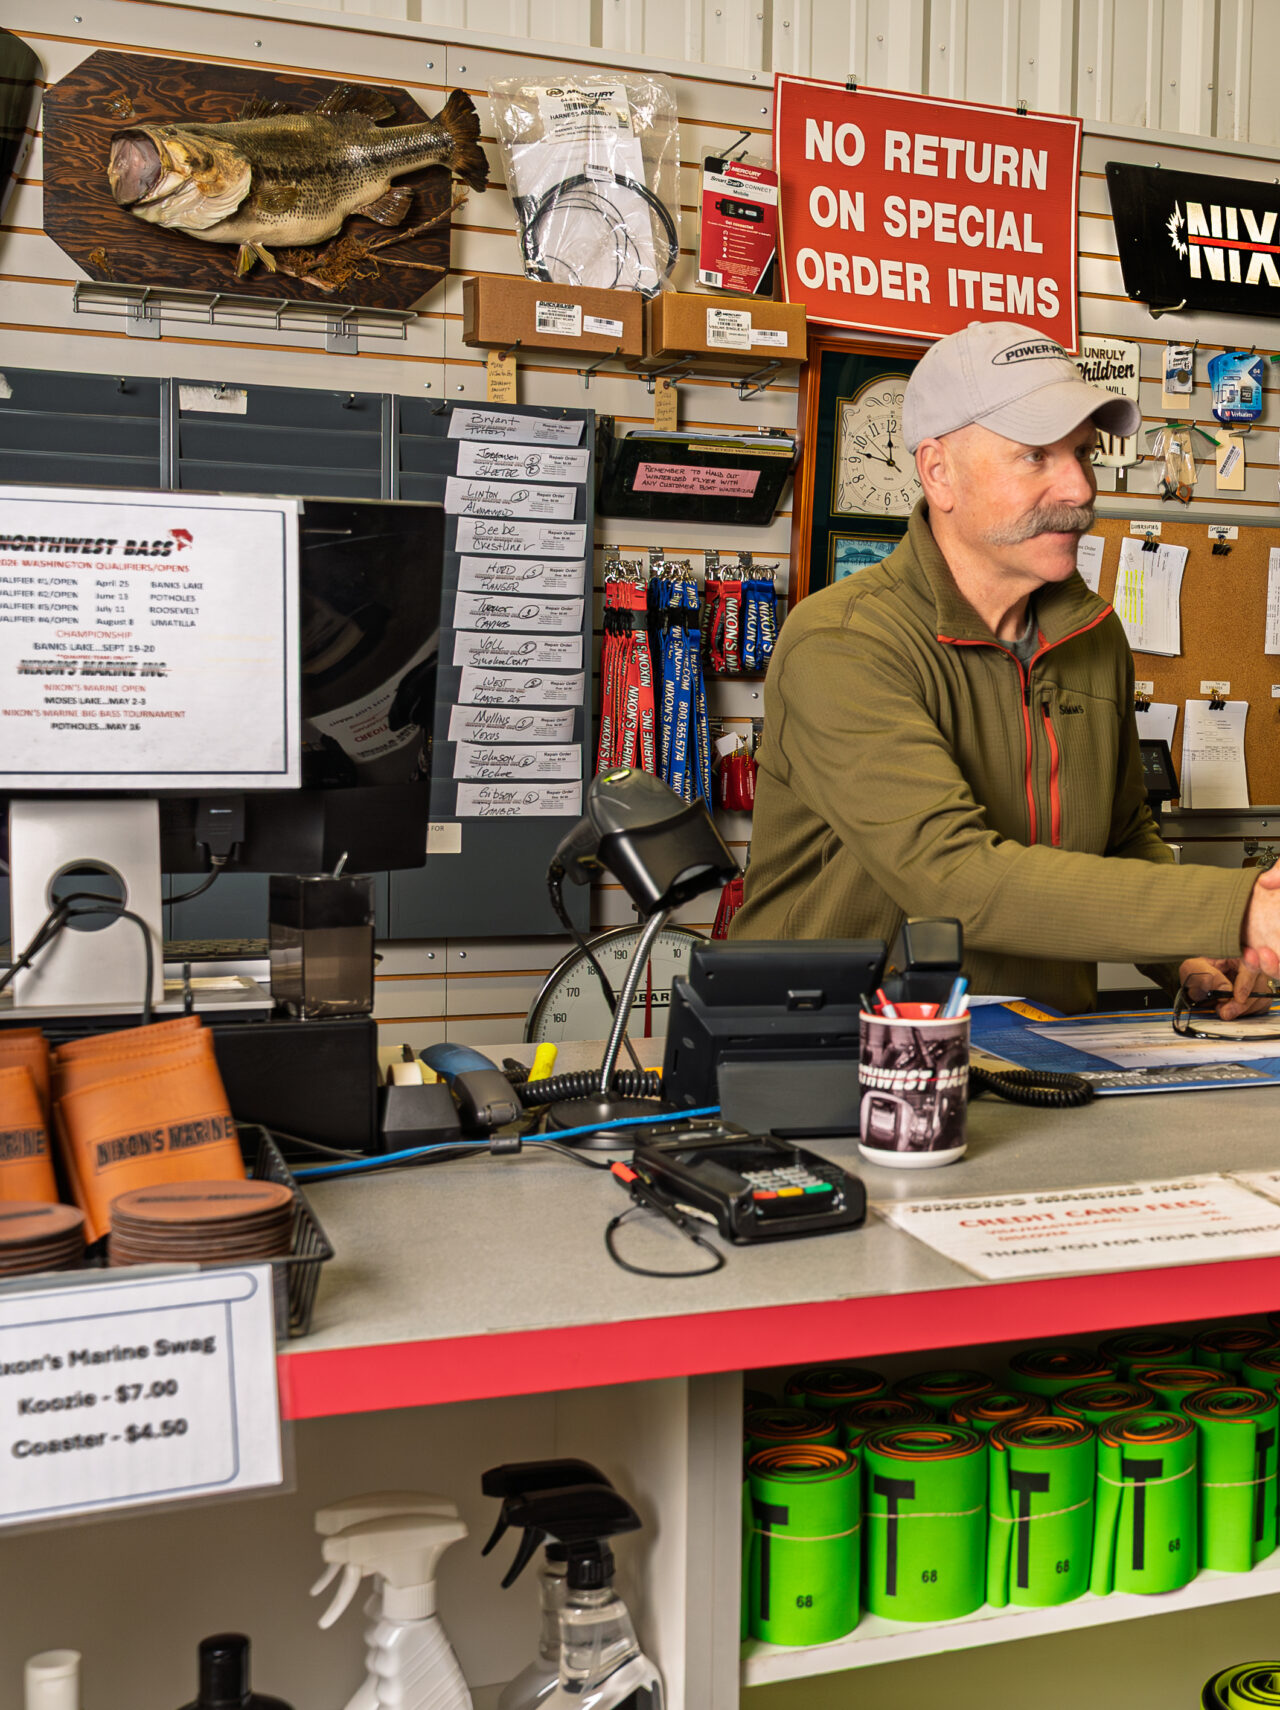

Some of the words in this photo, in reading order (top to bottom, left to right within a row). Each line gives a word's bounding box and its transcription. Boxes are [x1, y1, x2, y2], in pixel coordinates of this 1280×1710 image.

[550, 112, 579, 120] HARNESS
[580, 109, 611, 117] ASSEMBLY
[805, 117, 866, 166] NO
[884, 129, 1048, 191] RETURN
[731, 166, 762, 177] MERCURY
[744, 183, 772, 194] CONNECT
[809, 185, 865, 232] ON
[883, 195, 1043, 254] SPECIAL
[796, 247, 931, 304] ORDER
[948, 268, 1060, 319] ITEMS
[1084, 347, 1126, 360] UNRULY
[1105, 385, 1127, 396] WILL
[471, 413, 520, 424] Bryant
[868, 423, 881, 437] 11
[886, 419, 897, 434] 12
[853, 435, 867, 450] 10
[1094, 431, 1130, 457] AIT
[848, 456, 861, 464] 9
[644, 465, 685, 475] REMEMBER
[706, 470, 723, 478] HAND
[646, 474, 687, 482] WINTERIZED
[693, 475, 716, 484] FLYER
[659, 481, 694, 490] CUSTOMER
[852, 474, 864, 484] 8
[914, 478, 922, 488] 4
[865, 487, 876, 499] 7
[884, 492, 892, 506] 6
[901, 489, 910, 502] 5
[0, 535, 118, 555] NORTHWEST
[124, 539, 174, 557] BASS
[22, 559, 92, 569] WASHINGTON
[95, 562, 190, 572] QUALIFIERS/OPENS
[96, 580, 117, 588] April
[150, 581, 180, 589] BANKS
[96, 593, 114, 601] June
[150, 594, 196, 602] POTHOLES
[96, 606, 112, 614] July
[149, 606, 199, 615] ROOSEVELT
[96, 618, 126, 626] August
[151, 619, 196, 628] UMATILLA
[725, 597, 740, 656] NIXON'S
[759, 602, 774, 653] NIXON'S
[56, 630, 133, 639] CHAMPIONSHIP
[33, 642, 67, 651] BANKS
[80, 661, 138, 677] MARINE
[640, 645, 652, 688] NIXON'S
[44, 684, 81, 692] NIXON'S
[83, 684, 118, 692] MARINE
[121, 685, 146, 693] OPEN
[623, 685, 639, 729] NIXON'S
[662, 679, 675, 723] NIXON'S
[2, 709, 40, 717] NIXON'S
[43, 709, 78, 717] MARINE
[100, 710, 121, 718] BASS
[124, 710, 186, 718] TOURNAMENT
[643, 708, 653, 729] INC.
[600, 715, 612, 758] NIXON'S
[674, 701, 689, 761] 800.355.5774
[661, 723, 673, 764] MARINE
[643, 729, 655, 774] MARINE
[614, 950, 628, 960] 190
[673, 948, 682, 958] 10
[566, 987, 580, 998] 170
[553, 1013, 567, 1023] 160
[859, 1063, 934, 1091] THWEST
[97, 1130, 165, 1167] NIXONS
[168, 1115, 236, 1150] MARINE
[1034, 1188, 1144, 1204] MARINE
[959, 1212, 1057, 1228] CREDIT
[1065, 1205, 1140, 1219] CARD
[1145, 1200, 1215, 1212] FEES:
[981, 1247, 1050, 1259] THANK
[1055, 1241, 1098, 1251] YOU
[1102, 1238, 1144, 1247] FOR
[1146, 1232, 1199, 1242] YOUR
[0, 1354, 63, 1377] xon's
[68, 1345, 150, 1369] Marine
[154, 1335, 217, 1358] Swag
[17, 1391, 97, 1416] Koozie
[115, 1378, 179, 1405] $7.00
[11, 1432, 108, 1459] Coaster
[125, 1418, 188, 1445] $4.50
[1168, 1538, 1181, 1552] 68
[1055, 1559, 1070, 1574] 68
[922, 1569, 938, 1583] 68
[795, 1594, 813, 1608] 68
